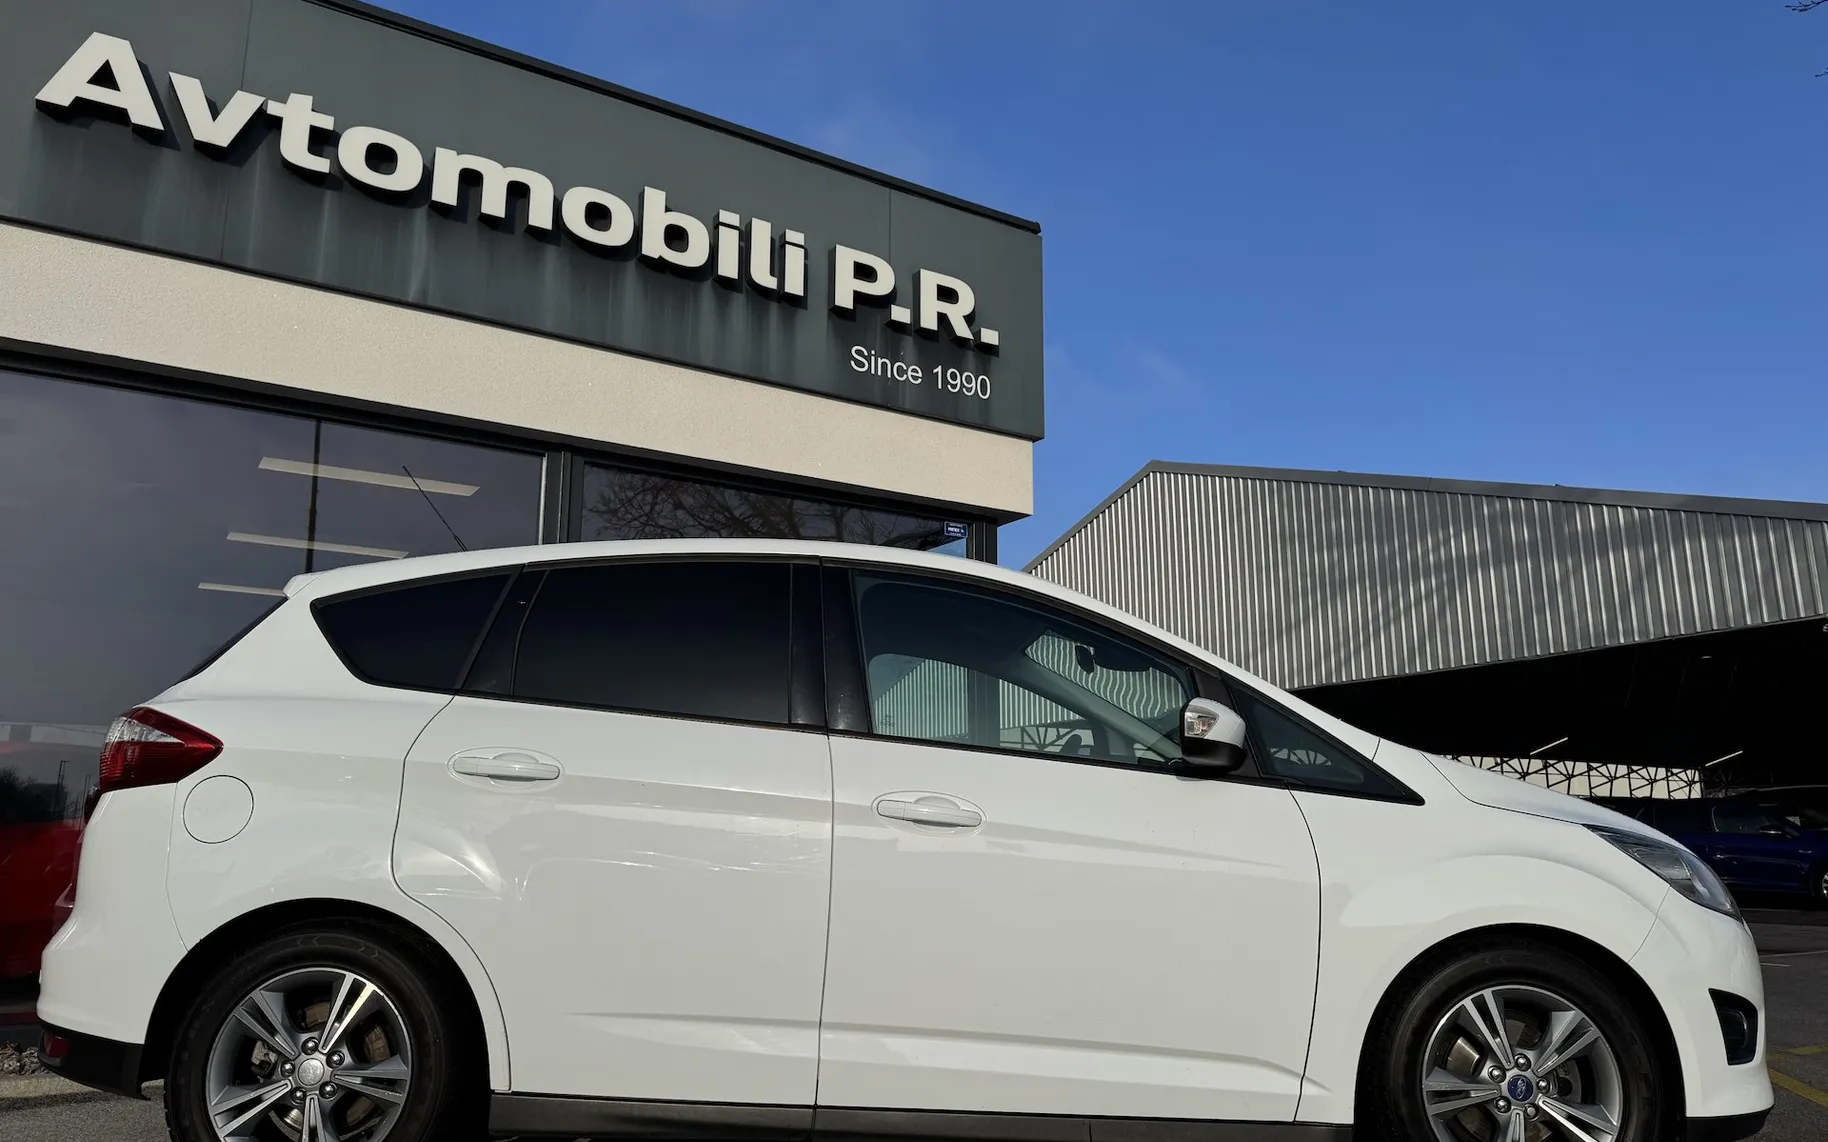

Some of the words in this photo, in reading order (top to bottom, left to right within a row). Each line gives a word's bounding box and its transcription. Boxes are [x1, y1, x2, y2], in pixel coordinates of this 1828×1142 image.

[35, 32, 806, 297] Avtomobili
[833, 244, 999, 346] P.R.
[850, 345, 923, 385] Since
[932, 365, 991, 400] 1990
